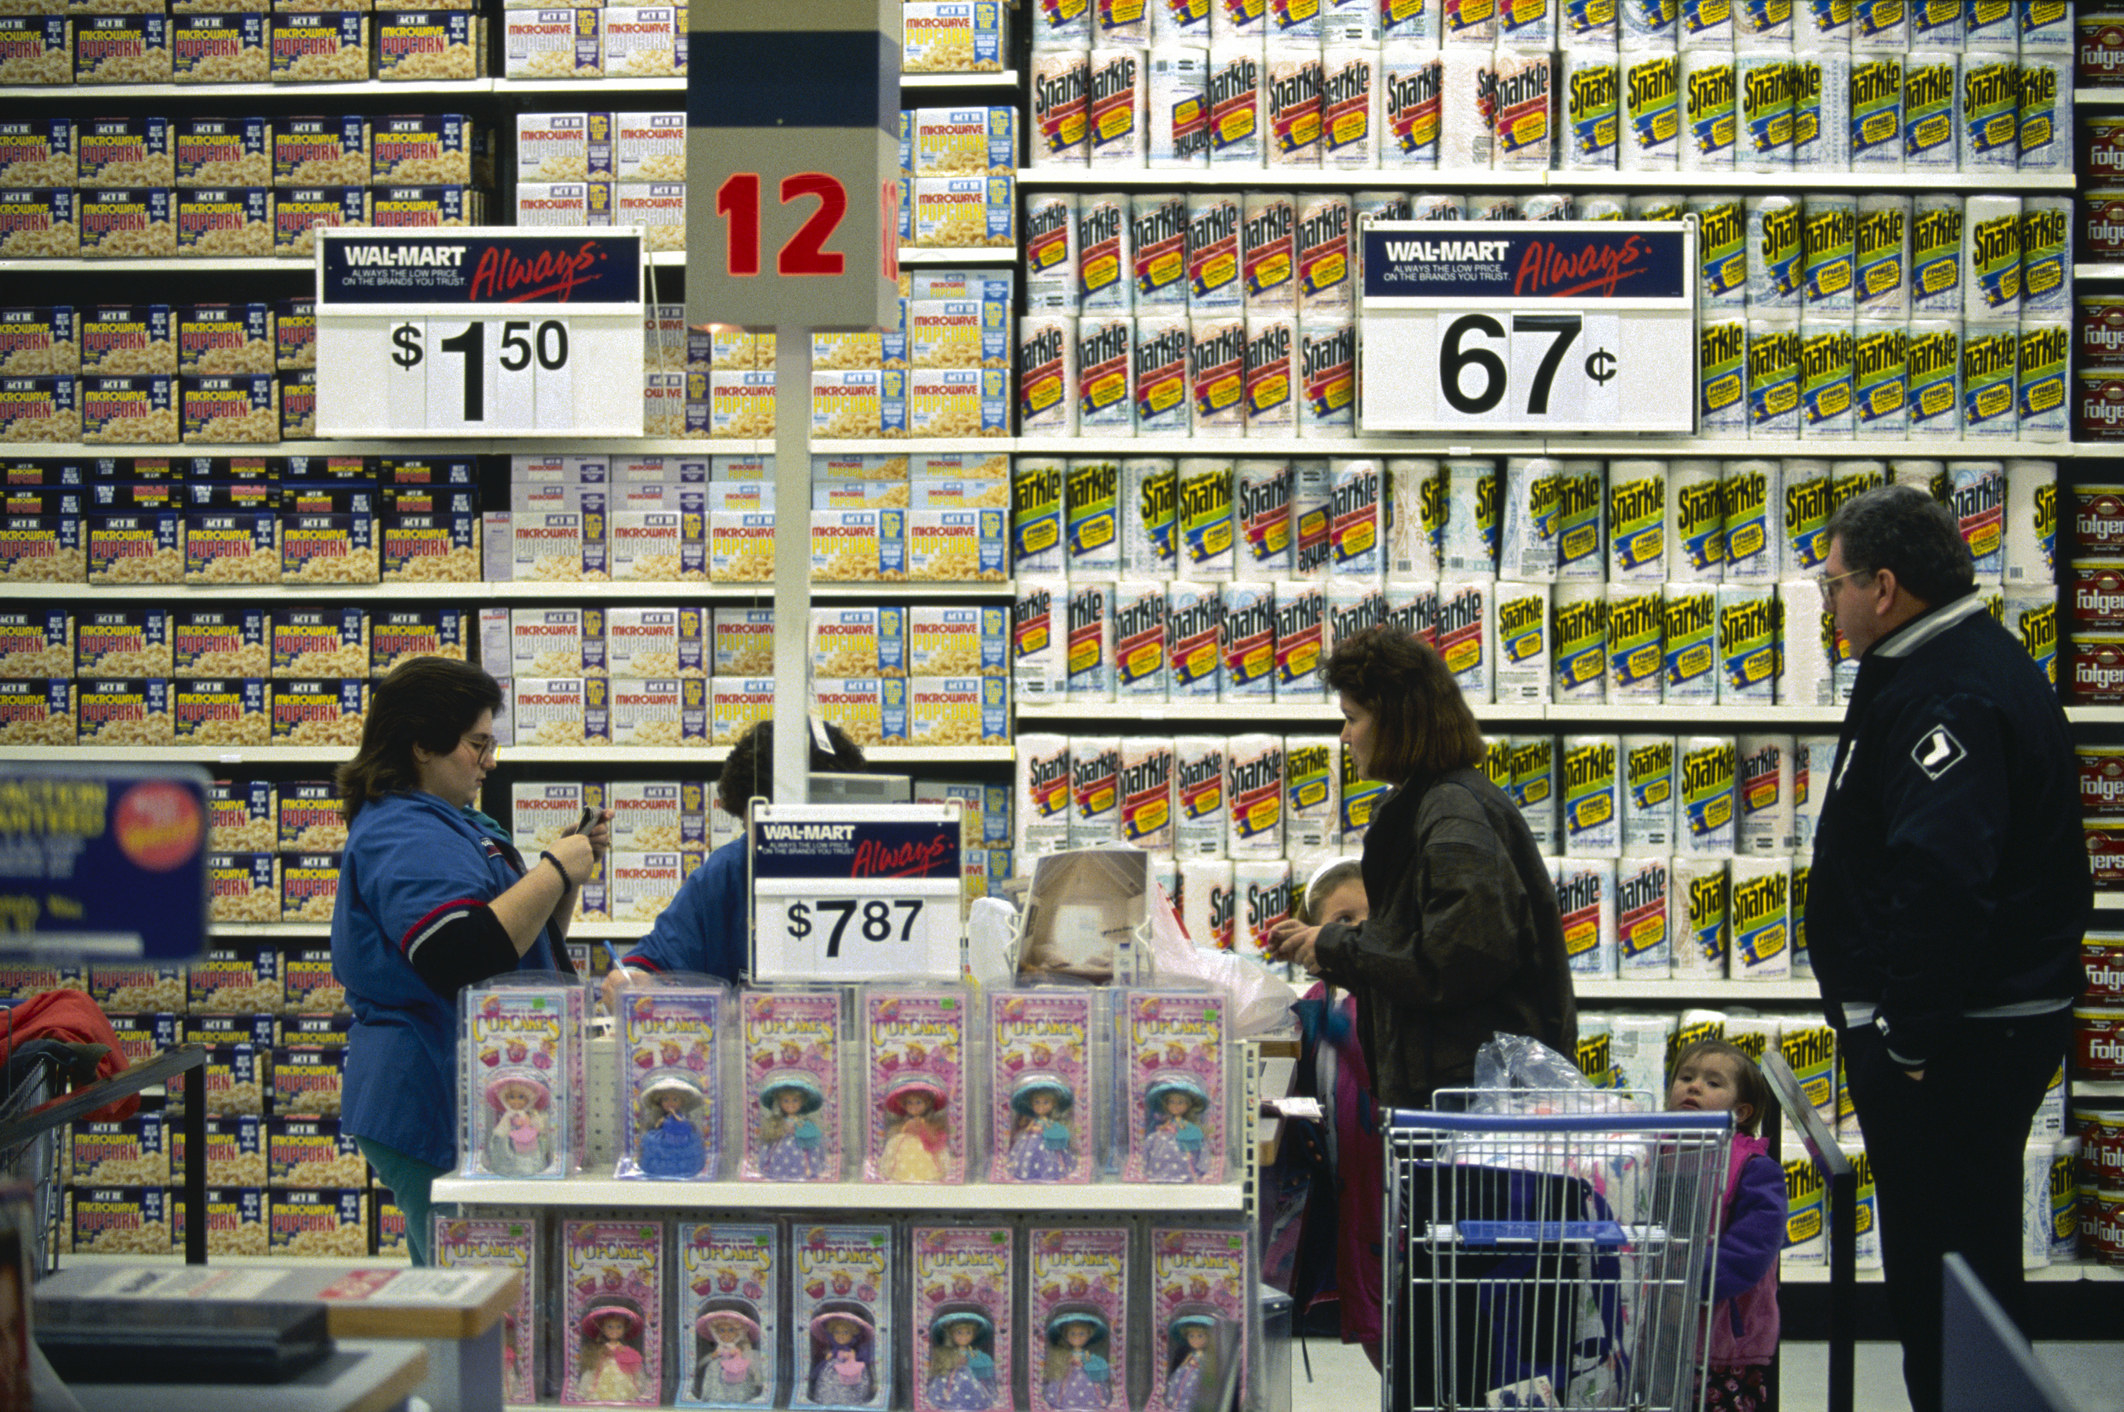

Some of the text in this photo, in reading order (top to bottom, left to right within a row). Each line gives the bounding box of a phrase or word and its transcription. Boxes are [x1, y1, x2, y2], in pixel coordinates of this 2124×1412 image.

[906, 18, 970, 28] MICROWAVE
[79, 30, 141, 40] MICROWAVE
[382, 26, 444, 38] MICROWAVE
[509, 25, 571, 34] MICROWAVE
[906, 29, 970, 45] POPCORN
[79, 41, 141, 57] POPCORN
[381, 37, 444, 54] POPCORN
[375, 133, 438, 143] MICROWAVE
[375, 144, 438, 160] POPCORN
[717, 171, 847, 276] 12
[344, 246, 466, 267] WAL-MART
[1385, 241, 1509, 262] WAL-MART
[352, 269, 458, 278] ALWAYS THE LOW PRICE
[1394, 264, 1501, 273] ALWAYS THE LOW PRICE
[342, 278, 356, 286] ON
[358, 278, 375, 286] THE
[377, 278, 413, 286] BRANDS
[414, 278, 434, 286] YOU
[1383, 273, 1398, 282] ON
[1400, 273, 1417, 282] THE
[1419, 273, 1456, 282] BRANDS
[1458, 273, 1478, 282] YOU
[914, 385, 976, 396] MICROWAVE
[914, 397, 977, 413] POPCORN
[92, 530, 154, 541] MICROWAVE
[516, 528, 578, 538] MICROWAVE
[92, 541, 154, 557] POPCORN
[275, 693, 338, 705] MICROWAVE
[914, 693, 978, 703] MICROWAVE
[275, 705, 338, 722] POPCORN
[914, 704, 978, 720] POPCORN
[1229, 750, 1281, 802] Sparkle
[615, 800, 677, 809] MICROWAVE
[763, 825, 855, 840] WAL-MART
[1733, 873, 1787, 930] Sparkle
[273, 1205, 335, 1215] MICROWAVE
[273, 1215, 335, 1231] POPCORN
